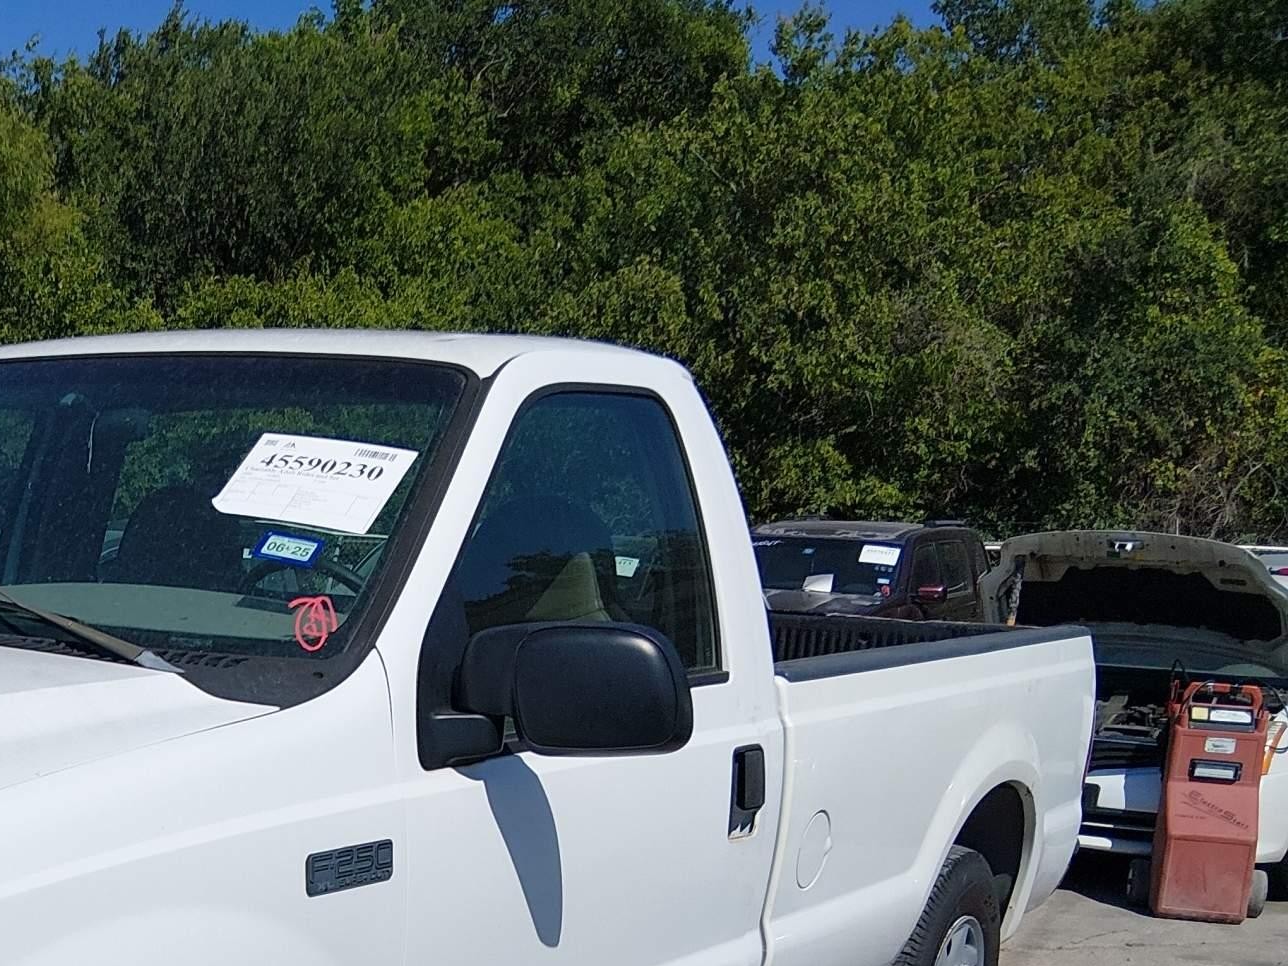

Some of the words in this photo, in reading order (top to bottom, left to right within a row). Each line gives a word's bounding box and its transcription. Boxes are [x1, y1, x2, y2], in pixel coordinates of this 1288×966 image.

[260, 453, 384, 482] 45590230
[266, 541, 285, 553] 06
[291, 546, 310, 558] 25
